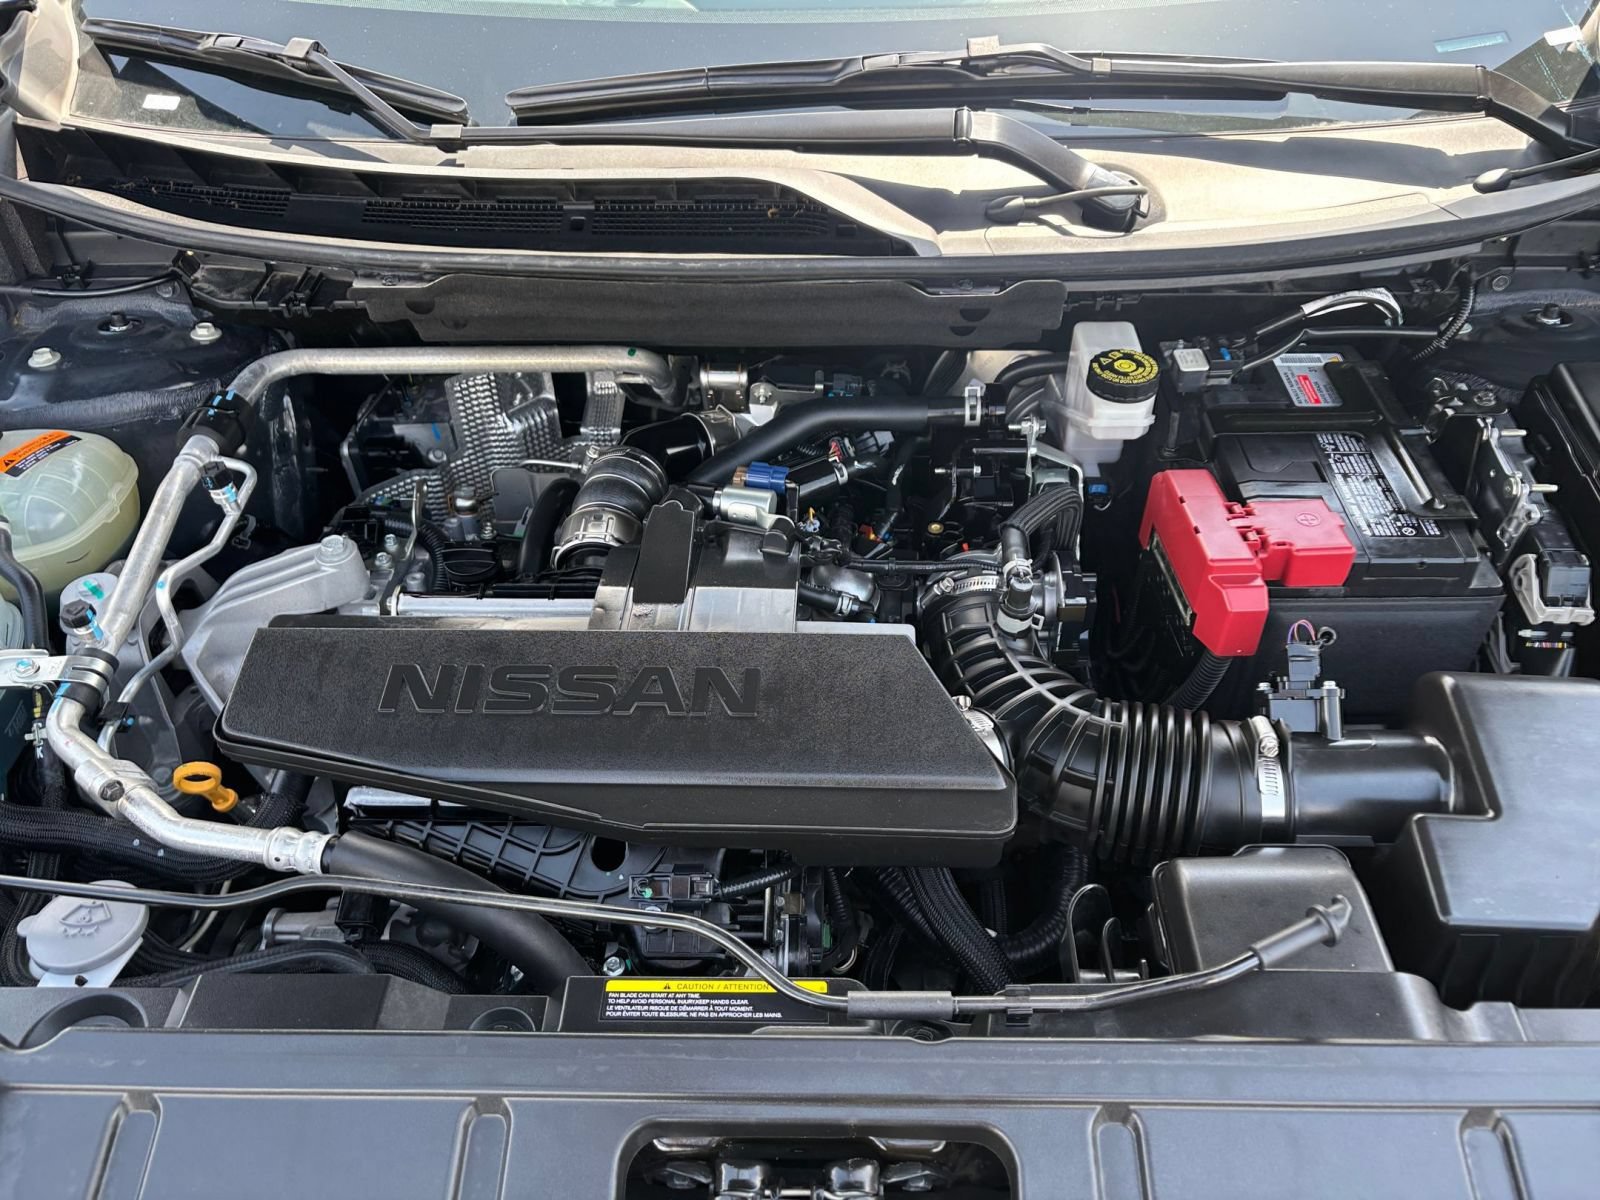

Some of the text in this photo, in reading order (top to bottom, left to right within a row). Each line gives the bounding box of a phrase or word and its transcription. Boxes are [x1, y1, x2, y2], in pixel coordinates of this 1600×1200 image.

[378, 663, 762, 718] NISSAN
[36, 746, 44, 759] K
[723, 983, 769, 991] ATTENTION
